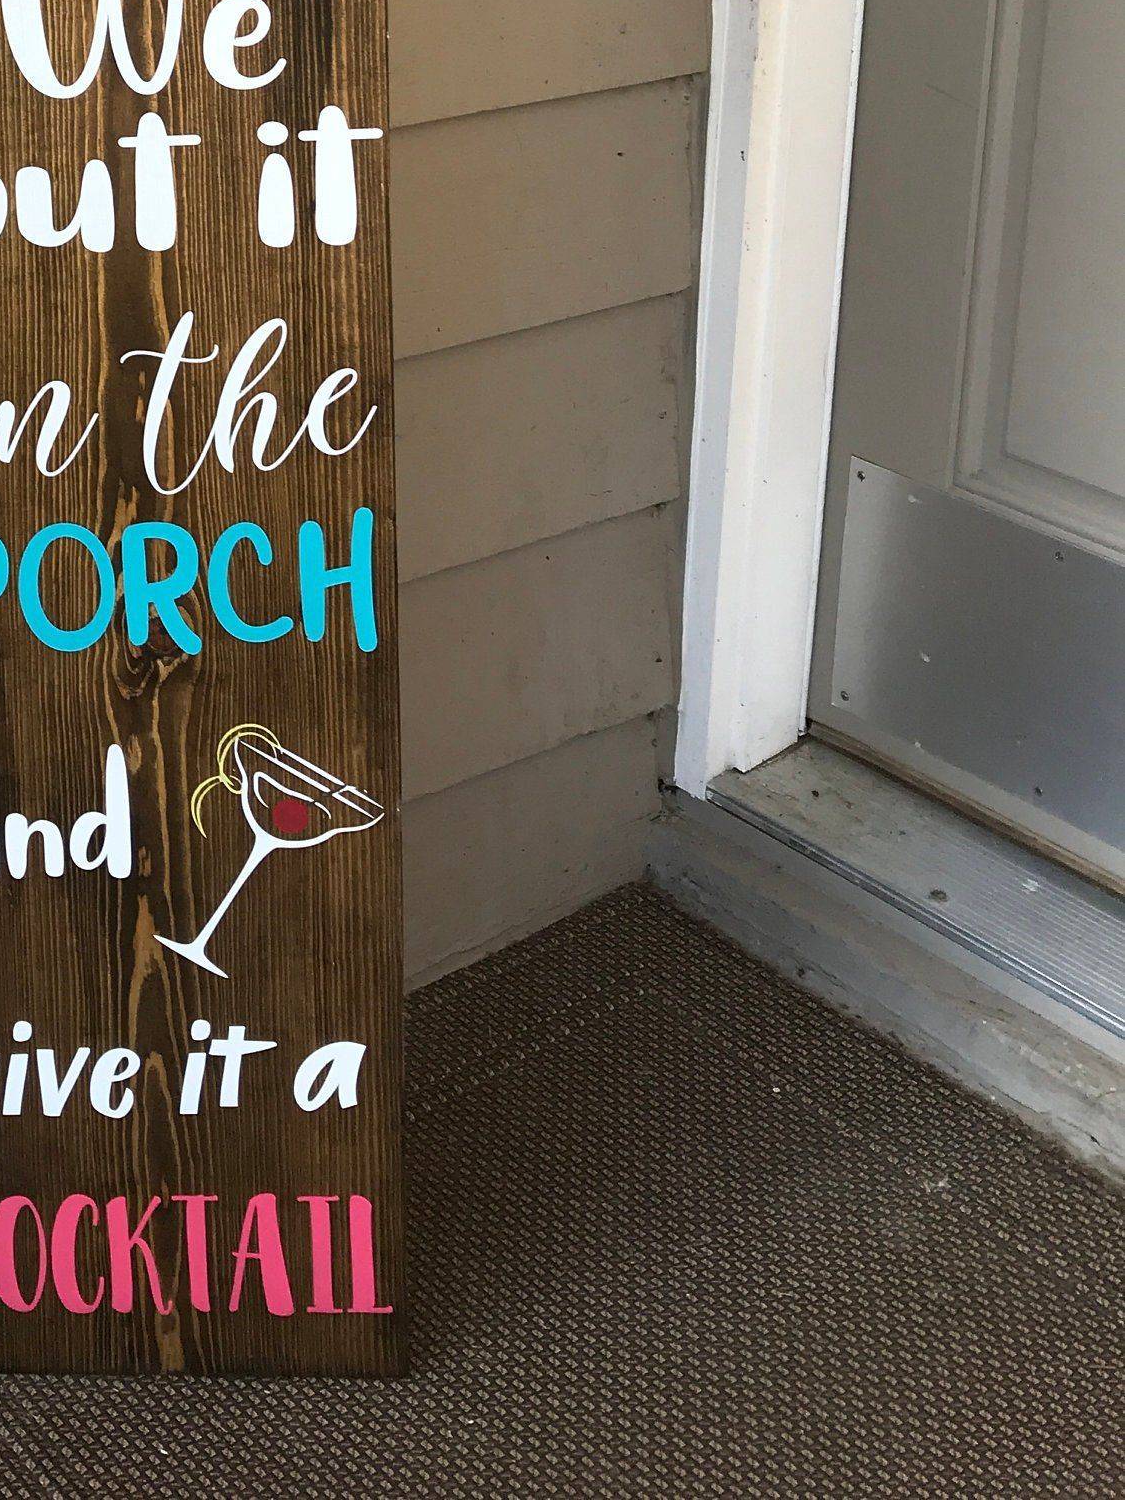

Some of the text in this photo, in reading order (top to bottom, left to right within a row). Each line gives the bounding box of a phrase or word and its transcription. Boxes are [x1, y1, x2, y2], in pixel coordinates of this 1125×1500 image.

[255, 104, 384, 249] it
[120, 310, 378, 496] the
[178, 1018, 278, 1117] it
[292, 1041, 367, 1116] a
